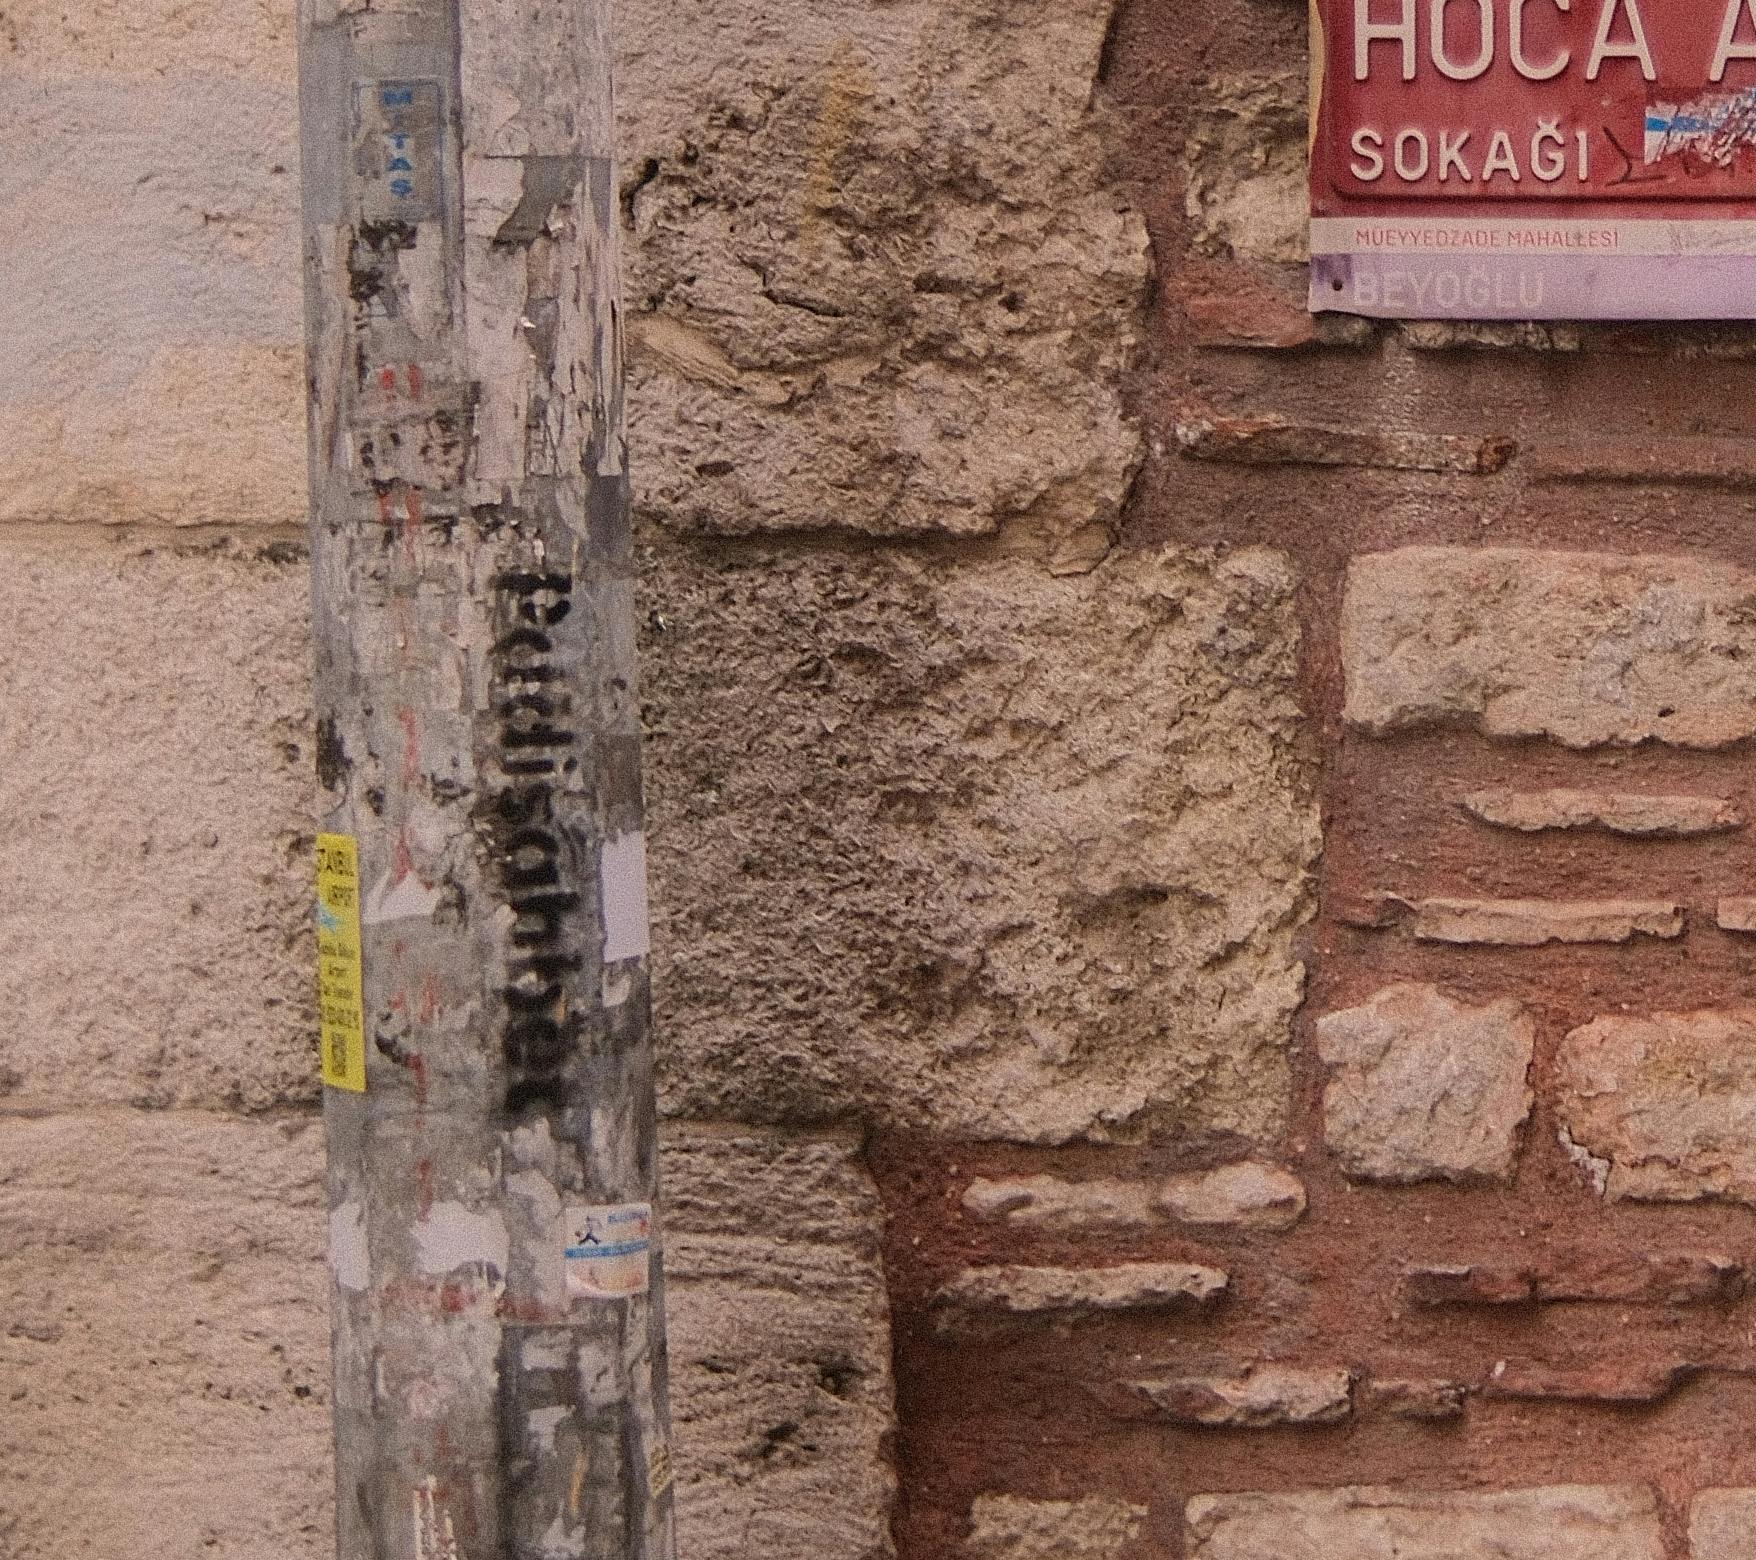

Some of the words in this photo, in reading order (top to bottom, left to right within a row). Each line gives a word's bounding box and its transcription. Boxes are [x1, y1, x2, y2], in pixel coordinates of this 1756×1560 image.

[1349, 120, 1590, 183] SOKAĞI
[1506, 226, 1620, 248] MAHALLESİ
[1352, 265, 1544, 310] BEYOĞLU
